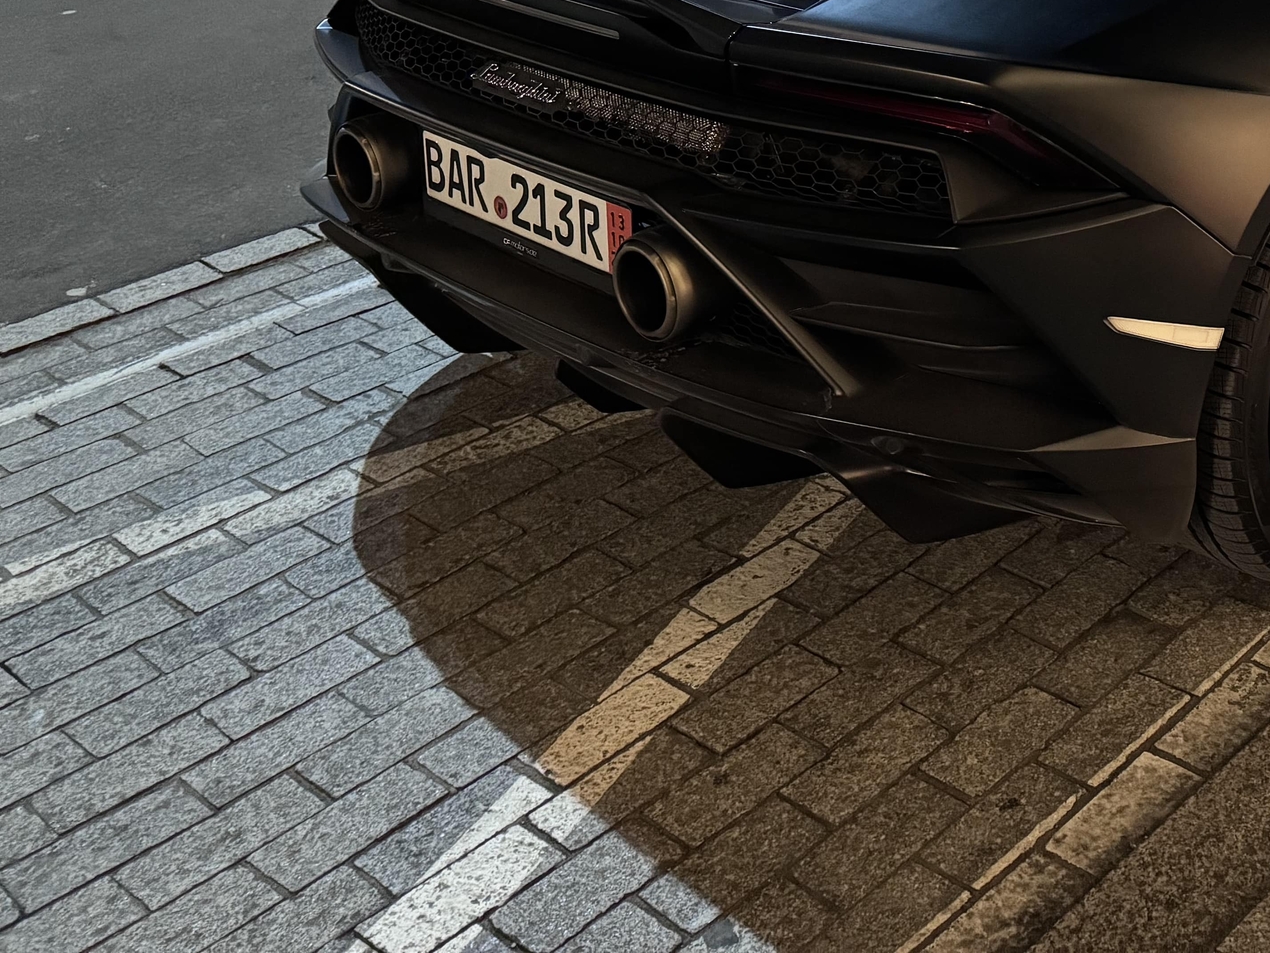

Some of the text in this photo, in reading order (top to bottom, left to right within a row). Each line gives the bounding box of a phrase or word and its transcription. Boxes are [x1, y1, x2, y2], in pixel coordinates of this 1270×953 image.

[470, 63, 561, 103] Lamborghini
[425, 138, 603, 262] BAR 213R
[610, 211, 625, 231] 13
